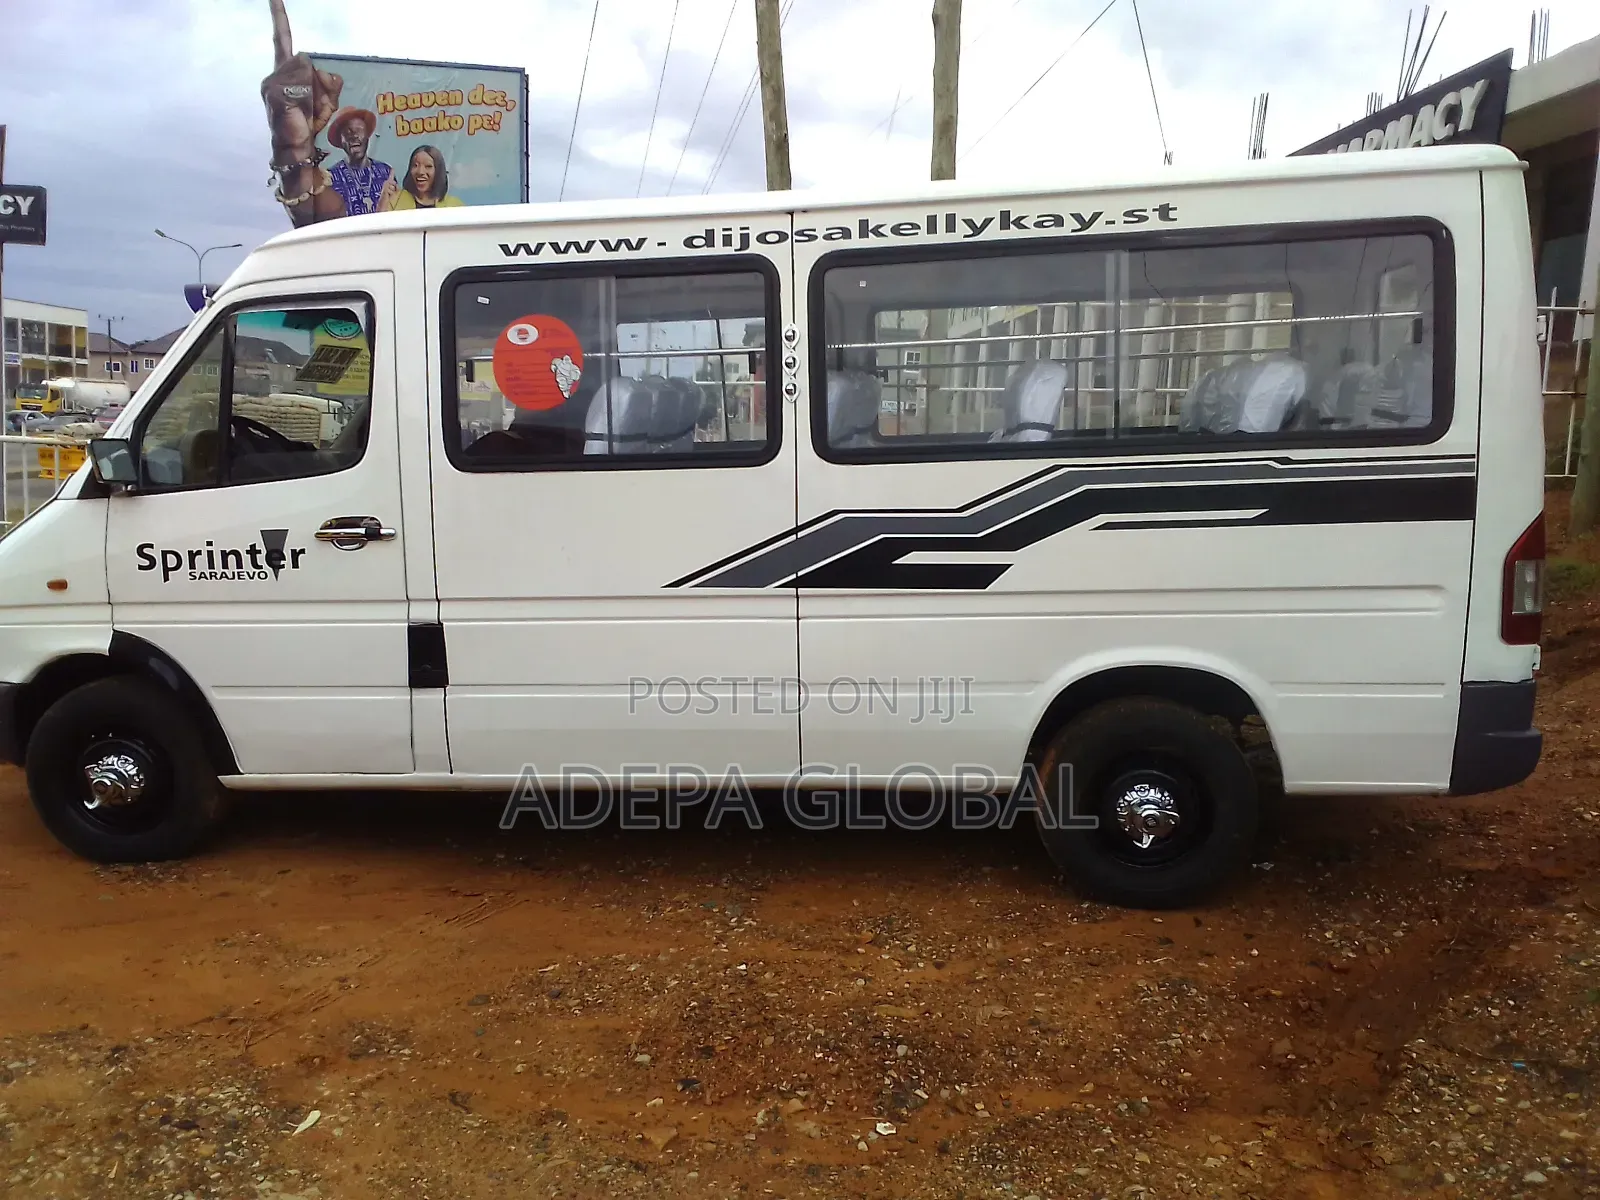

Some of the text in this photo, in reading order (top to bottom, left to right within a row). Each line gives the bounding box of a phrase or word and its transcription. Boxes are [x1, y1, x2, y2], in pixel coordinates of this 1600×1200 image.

[376, 89, 463, 114] Heaven
[395, 110, 464, 136] baako
[136, 541, 306, 583] Sprinter
[188, 570, 268, 581] SARAJEVO
